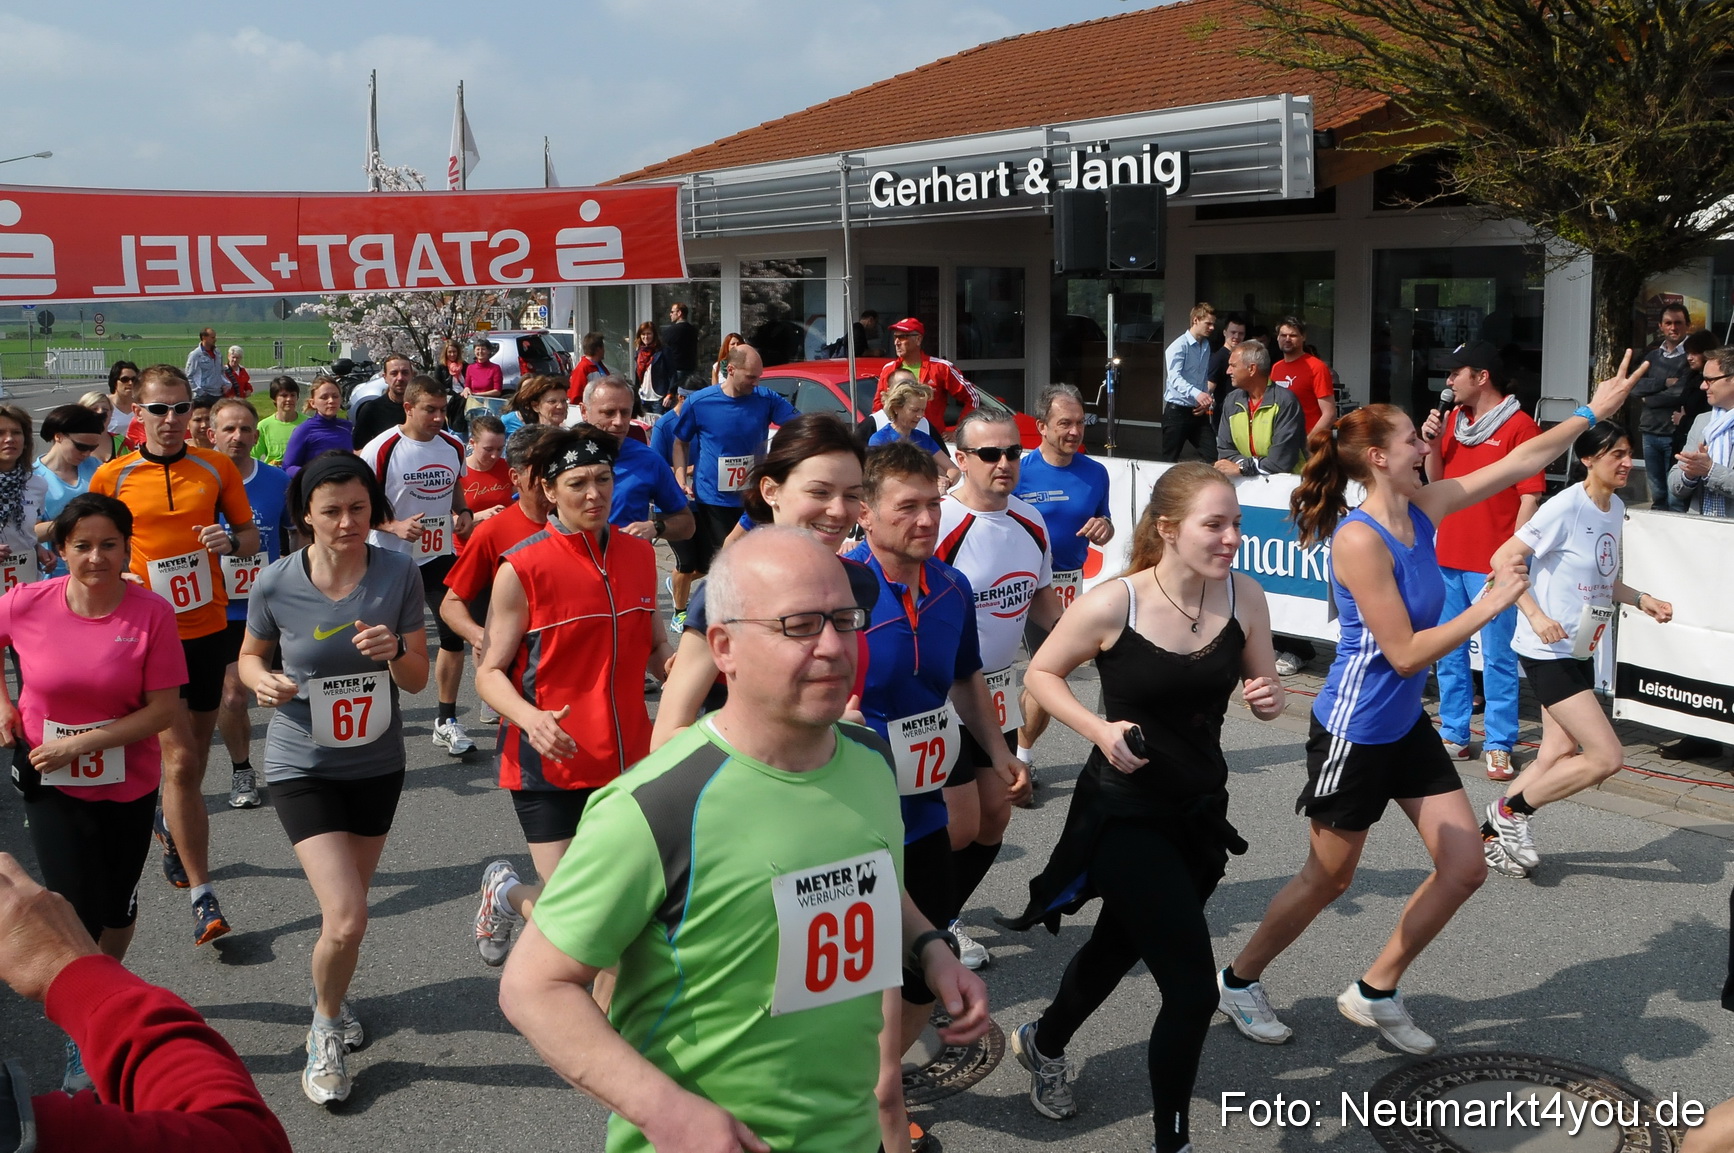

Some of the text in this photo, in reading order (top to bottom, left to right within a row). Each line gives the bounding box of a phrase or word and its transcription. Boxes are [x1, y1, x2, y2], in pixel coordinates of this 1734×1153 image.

[869, 140, 1184, 208] Gerhart & Jänig
[403, 470, 446, 481] GERHART
[727, 466, 748, 487] 79
[421, 528, 443, 553] 96
[157, 558, 187, 569] MEYER
[158, 564, 189, 574] WERBUNG
[1230, 534, 1331, 583] markt
[169, 571, 202, 608] 61
[973, 580, 1029, 602] GERHART
[975, 601, 1000, 609] utohaus
[1588, 623, 1606, 652] 9
[323, 678, 360, 690] MEYER
[323, 686, 361, 696] WERBUNG
[986, 674, 1004, 685] EYER
[1638, 678, 1728, 714] Leistungen,
[332, 696, 373, 742] 67
[902, 714, 937, 732] MEYER
[902, 724, 938, 739] WERBUNG
[909, 736, 947, 788] 72
[795, 867, 853, 896] MEYER
[797, 884, 855, 908] WERBUNG
[805, 901, 875, 993] 69
